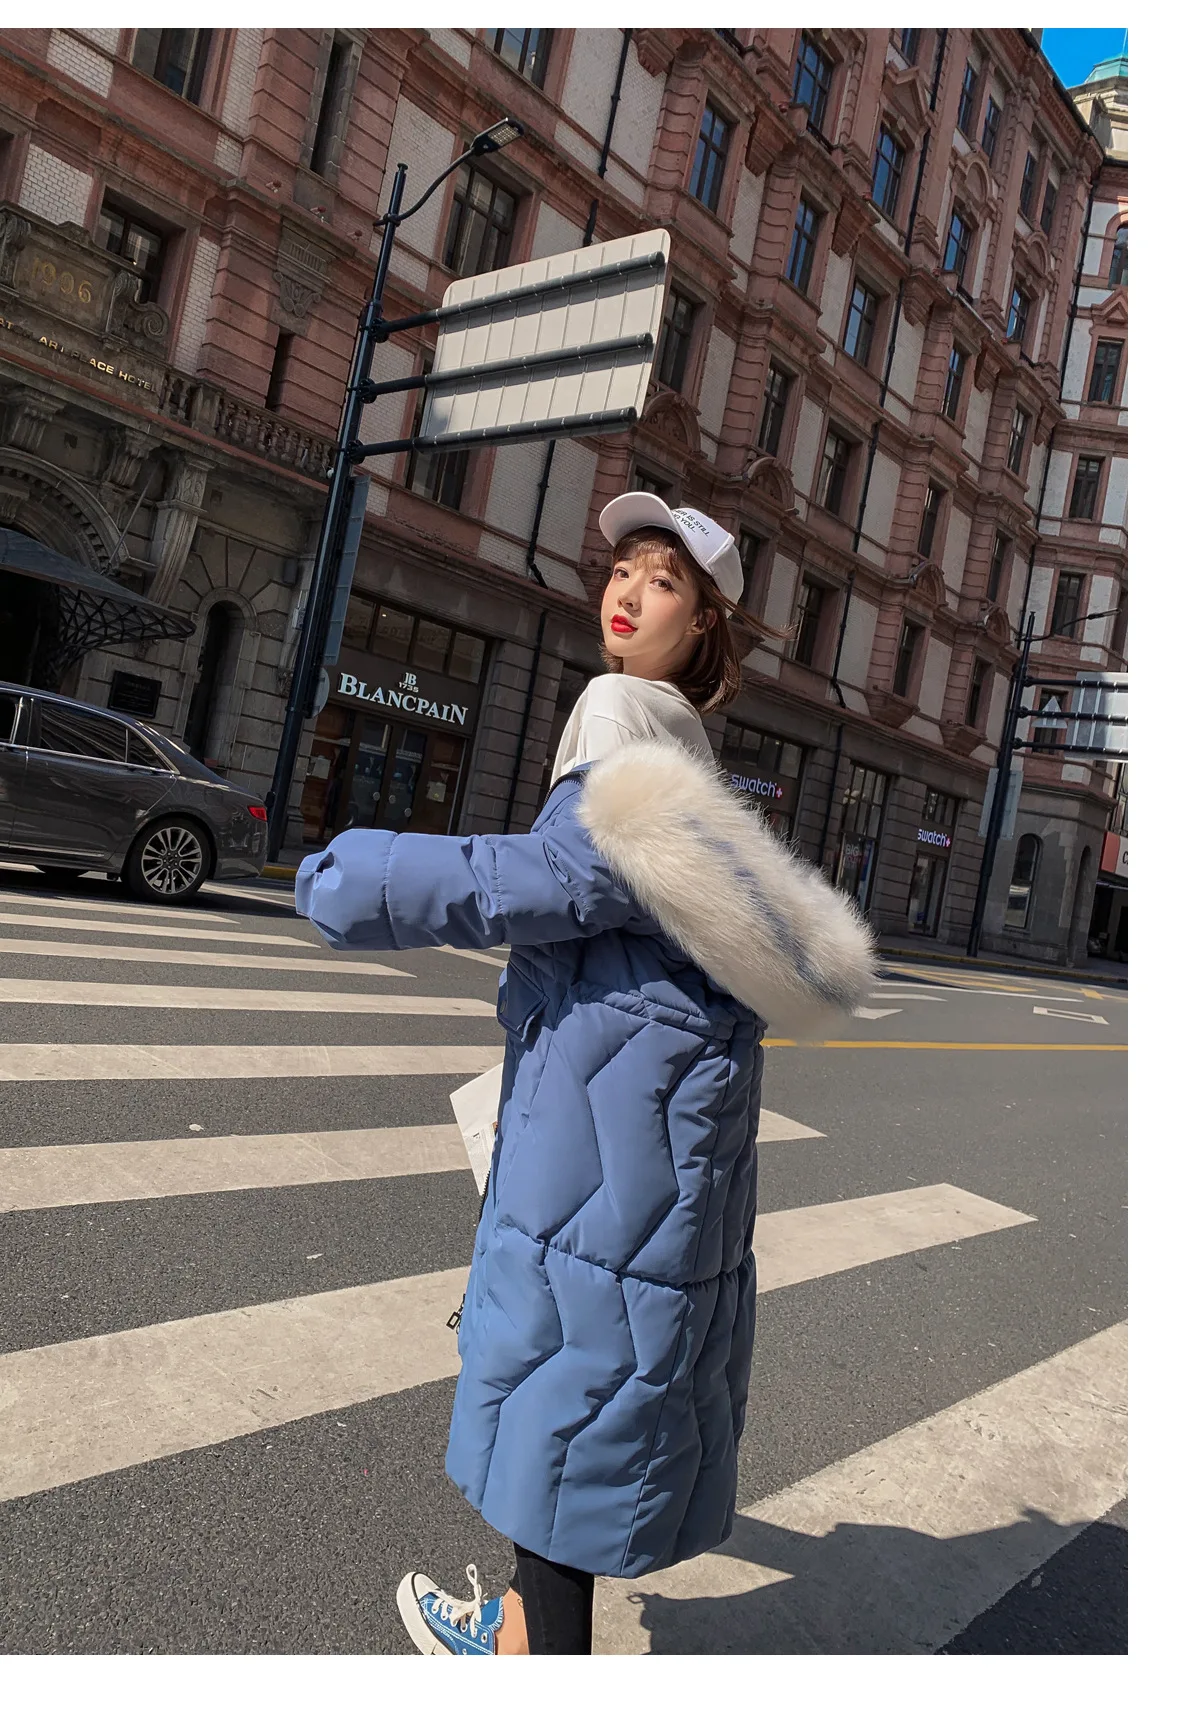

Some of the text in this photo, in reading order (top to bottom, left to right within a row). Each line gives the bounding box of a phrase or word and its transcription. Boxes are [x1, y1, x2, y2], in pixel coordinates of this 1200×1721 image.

[119, 371, 157, 393] HOTEL
[399, 681, 420, 693] 1735
[338, 672, 469, 726] BLANCPAIN
[730, 774, 777, 798] swatch
[918, 828, 947, 847] swatch
